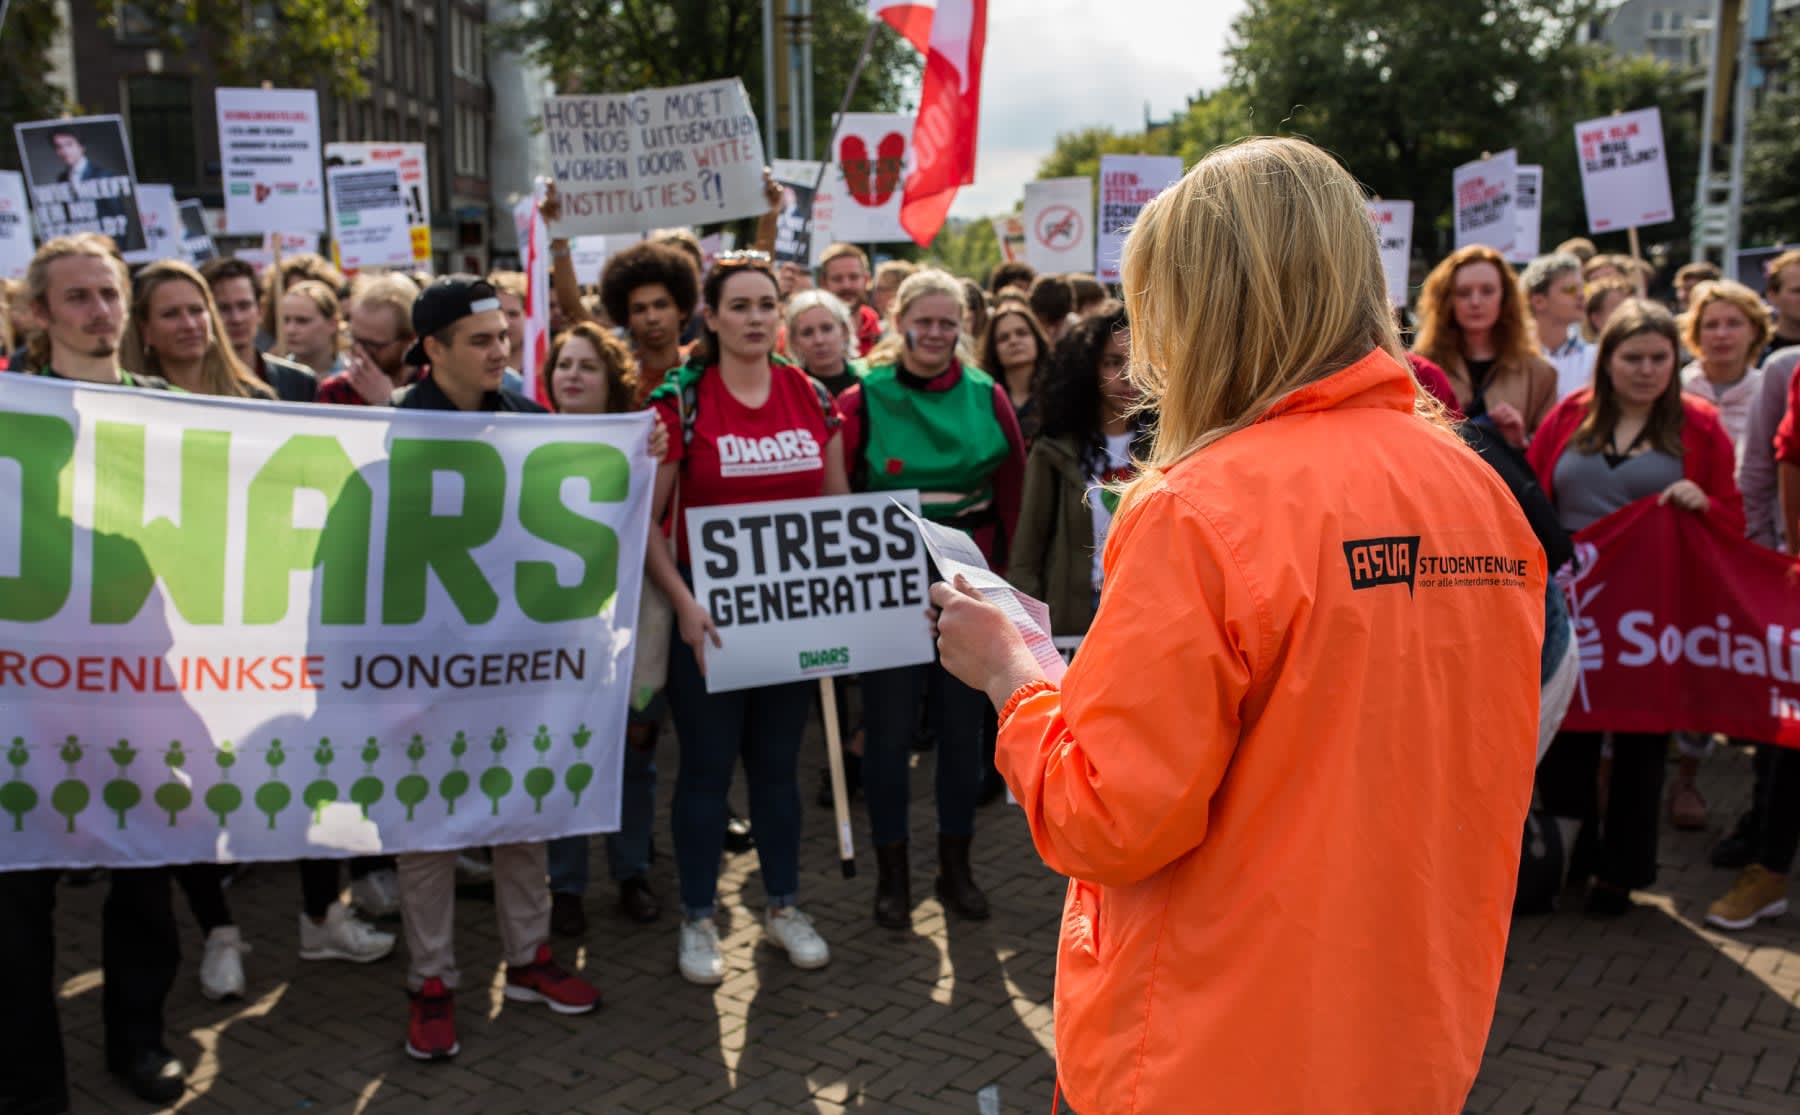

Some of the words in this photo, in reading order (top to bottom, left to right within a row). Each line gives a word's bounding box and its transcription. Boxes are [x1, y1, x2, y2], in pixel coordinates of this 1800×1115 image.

[544, 96, 649, 128] HOELANG
[664, 87, 723, 120] MOET
[550, 130, 573, 153] IK
[583, 130, 629, 153] NOG
[553, 159, 628, 181] WORDEN
[637, 151, 687, 177] DOOR
[692, 140, 753, 168] WITTE
[717, 428, 821, 464] DWARS
[702, 504, 915, 580] STRESS
[710, 568, 922, 628] GENERATIE
[1438, 577, 1453, 588] alle
[341, 648, 586, 690] JONGEREN
[799, 646, 849, 669] DWARS
